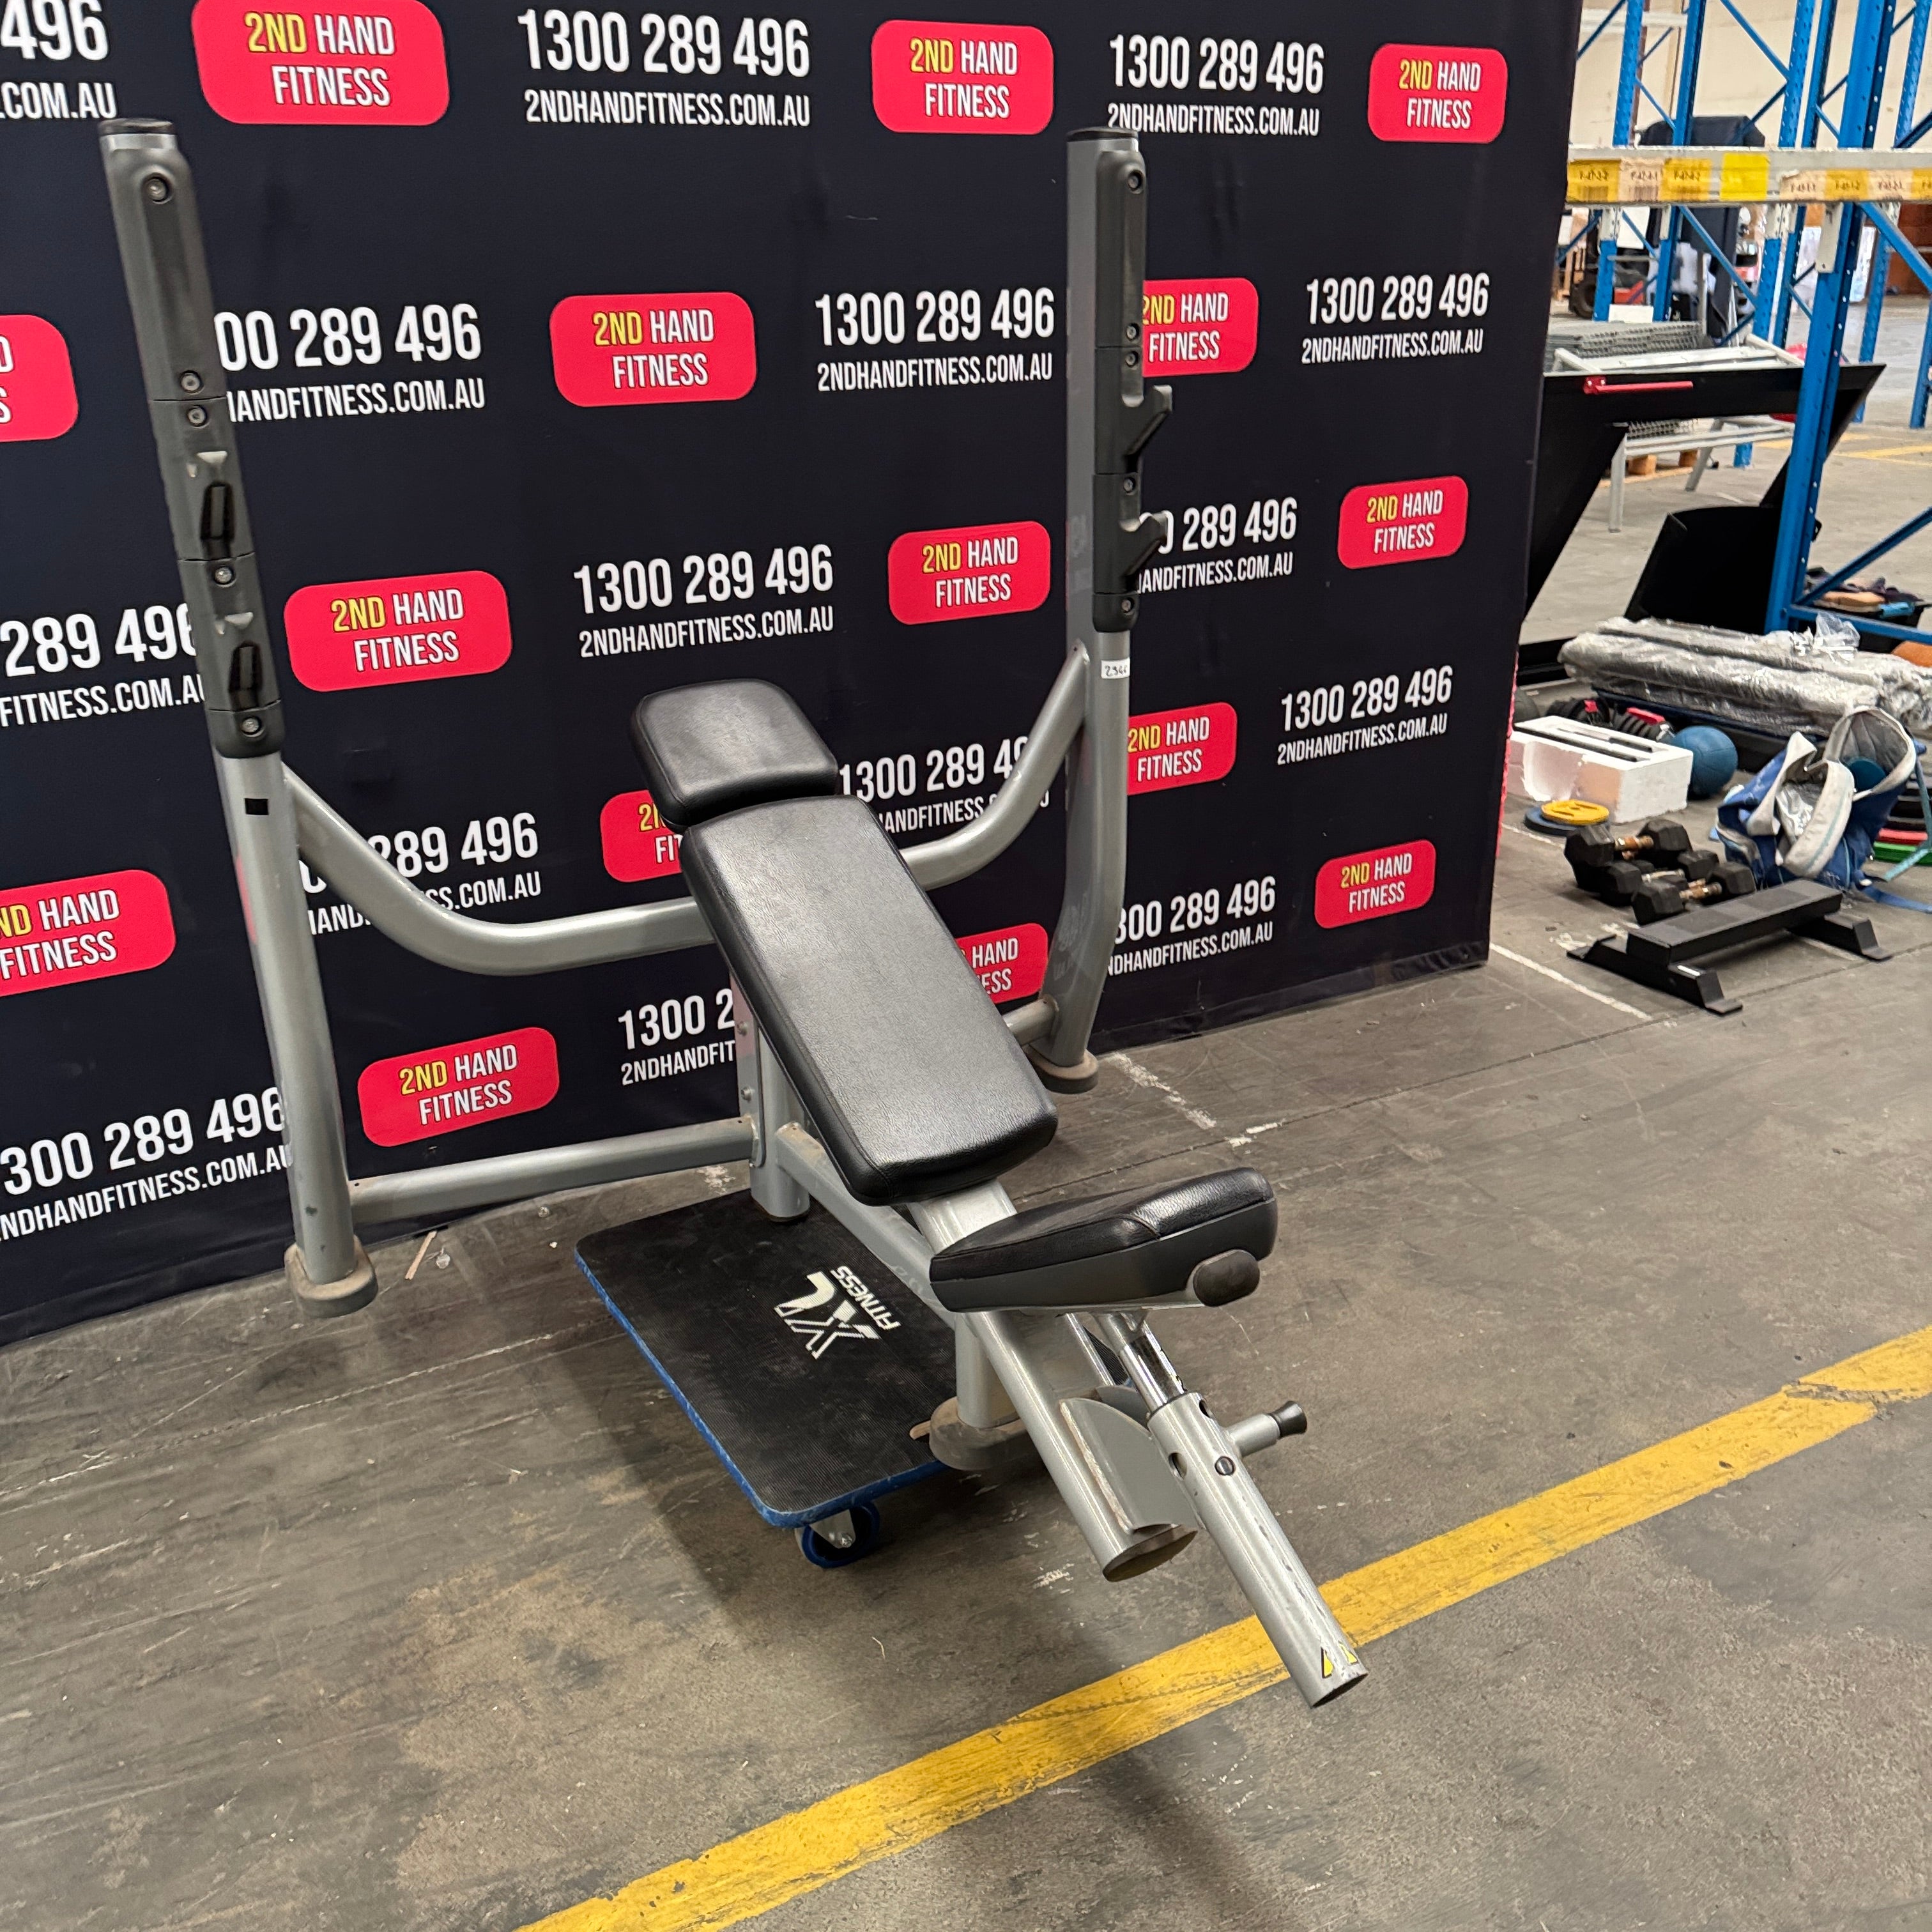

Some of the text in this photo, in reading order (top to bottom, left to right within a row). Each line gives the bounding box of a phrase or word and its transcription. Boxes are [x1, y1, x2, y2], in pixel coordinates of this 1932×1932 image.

[0, 0, 110, 61] 496
[245, 13, 394, 54] 2ND HAND
[518, 9, 809, 77] 1300 289 496
[910, 38, 1016, 74] 2ND HAND
[1110, 34, 1324, 93] 1300 289 496
[1400, 61, 1480, 91] 2ND HAND
[272, 66, 390, 105] FITNESS
[926, 83, 1009, 118] FITNESS
[525, 89, 809, 126] 2NDHANDFITNESS.COM.AU
[1108, 103, 1320, 137] 2NDHANDFITNESS.COM.AU
[1407, 98, 1471, 128] FITNESS
[815, 288, 1054, 346] 1300 289 496
[1181, 293, 1228, 323] HAND
[1307, 273, 1489, 324] 1300 289 496
[290, 307, 381, 367] 289
[395, 303, 480, 362] 496
[594, 310, 714, 345] 2ND HAND
[1149, 331, 1220, 362] FITNESS
[1302, 328, 1483, 364] 2NDHANDFITNESS.COM.AU
[613, 353, 707, 388] FITNESS
[818, 353, 1052, 391] 2NDHANDFITNESS.COM.AU
[1183, 504, 1236, 551] 289
[1244, 497, 1297, 542] 496
[1367, 490, 1443, 522] 2ND HAND
[923, 537, 1018, 572] 2ND HAND
[1374, 523, 1434, 553] FITNESS
[574, 544, 832, 613] 1300 289 496
[937, 574, 1010, 607] FITNESS
[332, 590, 463, 631] 2ND HAND
[0, 610, 102, 678] 289
[355, 631, 458, 671] FITNESS
[579, 606, 832, 657] 2NDHANDFITNESS.COM.AU
[1282, 666, 1452, 731] 1300 289 496
[1127, 717, 1209, 753] 2ND HAND
[1278, 712, 1447, 765] 2NDHANDFITNESS.COM.AU
[839, 754, 916, 804] 1300
[927, 744, 984, 791] 289
[1138, 749, 1202, 781] FITNESS
[461, 813, 538, 865] 496
[1342, 854, 1412, 887] 2ND HAND
[39, 890, 119, 930] HAND
[1170, 889, 1219, 932] 289
[1227, 877, 1275, 918] 496
[1349, 882, 1404, 912] FITNESS
[0, 930, 118, 979] FITNESS
[972, 938, 1018, 968] HAND
[618, 995, 705, 1049] 1300
[400, 1045, 516, 1094] 2ND HAND
[420, 1080, 511, 1124] FITNESS
[104, 1109, 193, 1170] 289
[206, 1087, 284, 1144] 496
[830, 1266, 901, 1330] FITNESS
